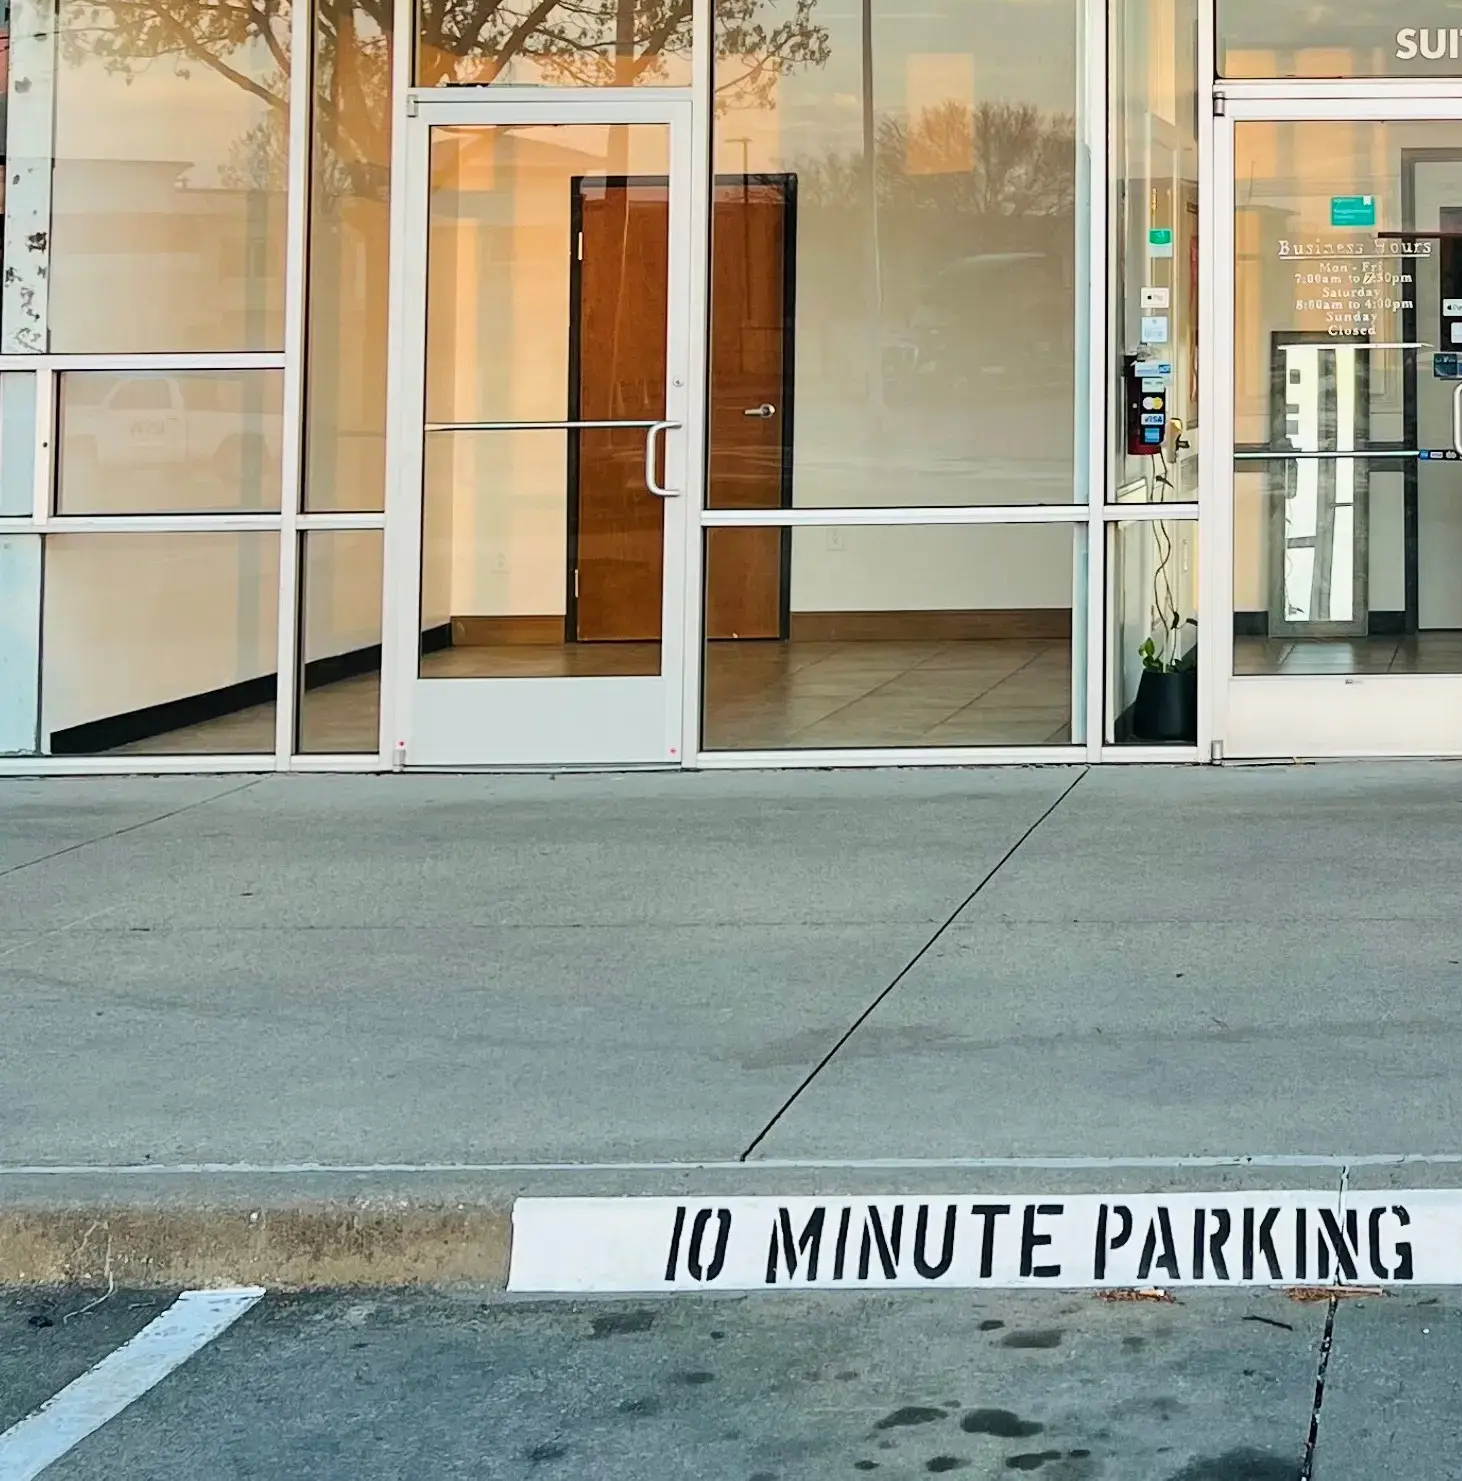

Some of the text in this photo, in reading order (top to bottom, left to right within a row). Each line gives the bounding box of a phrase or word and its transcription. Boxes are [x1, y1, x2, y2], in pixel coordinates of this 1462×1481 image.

[1278, 239, 1364, 255] Business
[1319, 262, 1348, 273] Mon
[1361, 261, 1385, 273] Fri
[1349, 274, 1361, 284] to
[1322, 287, 1381, 300] Saturday
[1348, 300, 1361, 310] to
[1364, 299, 1413, 312] 4:00pm
[1326, 312, 1378, 325] Sunday
[1328, 325, 1377, 336] Closed
[665, 1203, 1415, 1282] 10 MINUTE PARKING
